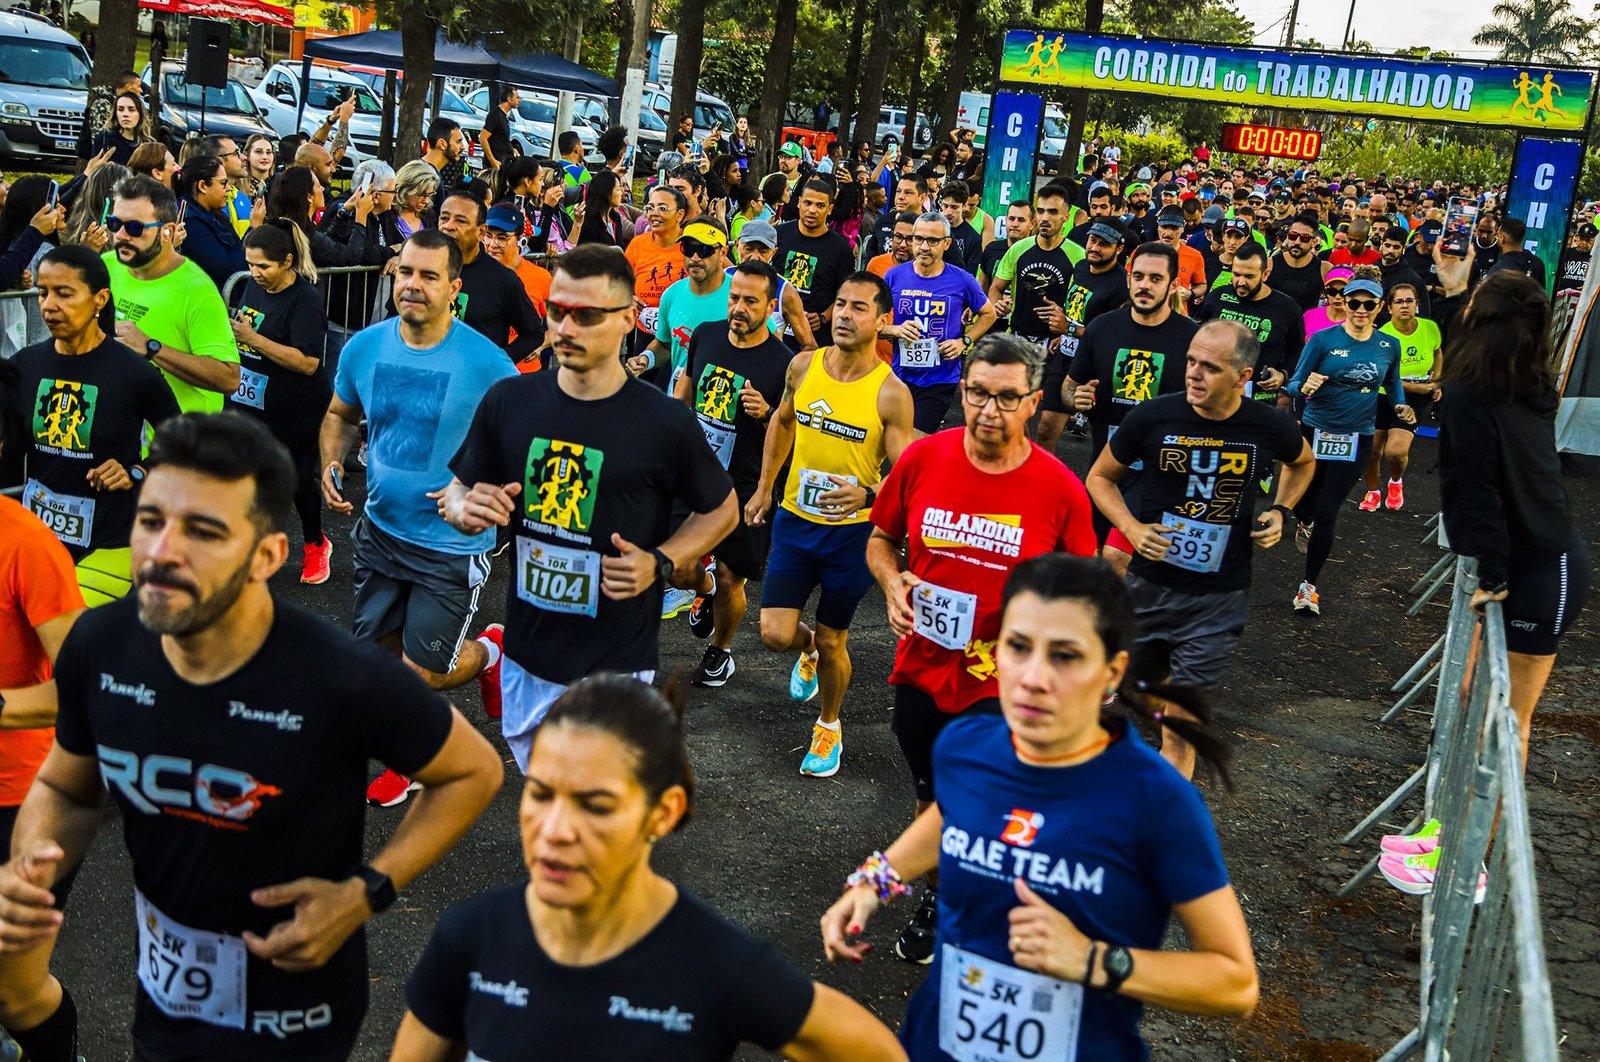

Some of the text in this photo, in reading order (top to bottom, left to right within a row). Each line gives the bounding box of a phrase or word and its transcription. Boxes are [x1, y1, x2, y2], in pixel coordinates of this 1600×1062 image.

[1093, 46, 1474, 111] CORRIDA do TRABALHADOR
[1239, 127, 1318, 157] 0:00:00
[906, 350, 931, 362] 587
[237, 383, 256, 400] 06
[1320, 441, 1348, 455] 1139
[35, 505, 79, 535] 1093
[48, 502, 65, 511] 10K
[921, 524, 1021, 557] TREINAMENTOS
[922, 507, 1024, 546] ORLANDINI
[1188, 529, 1204, 539] 5K
[548, 559, 568, 569] 10K
[1168, 536, 1212, 563] 593
[531, 568, 583, 602] 1104
[934, 596, 951, 609] 5K
[921, 606, 960, 639] 561
[97, 744, 258, 820] RCO
[942, 826, 1006, 871] GRAE
[1011, 847, 1104, 895] TEAM
[162, 931, 187, 957] 5K
[147, 942, 213, 1001] 679
[990, 983, 1021, 1007] 5K
[253, 1003, 332, 1039] RCO
[957, 999, 1045, 1059] 540
